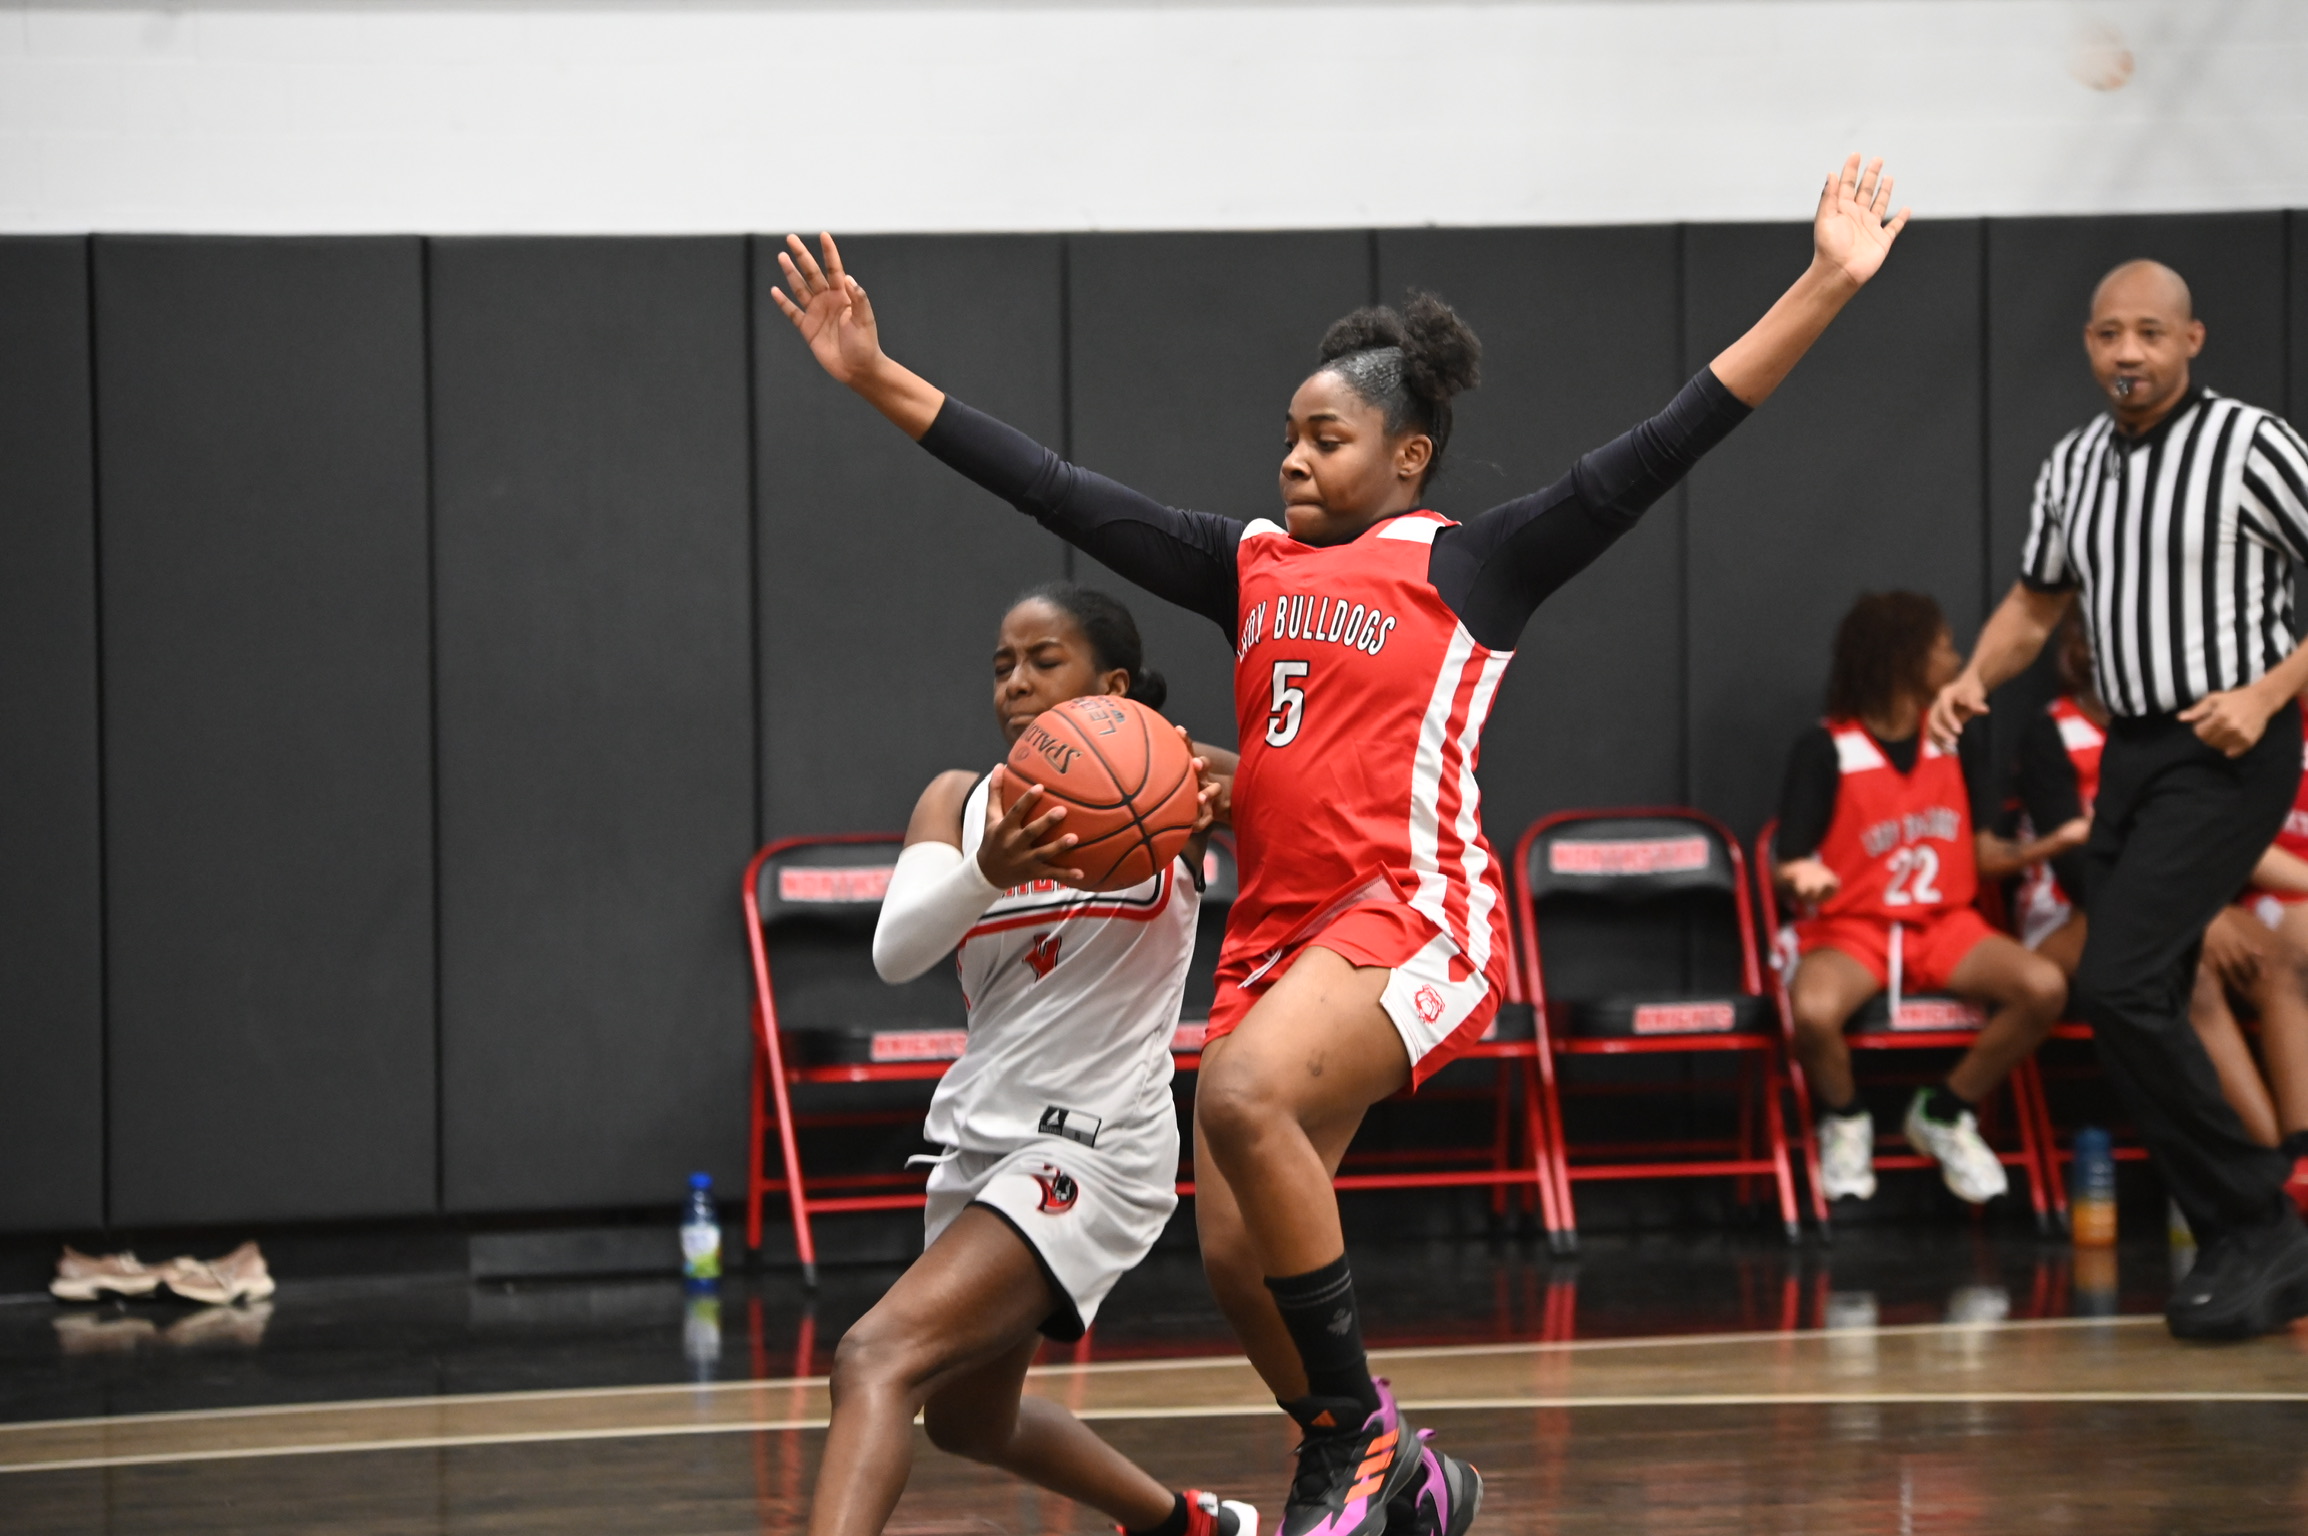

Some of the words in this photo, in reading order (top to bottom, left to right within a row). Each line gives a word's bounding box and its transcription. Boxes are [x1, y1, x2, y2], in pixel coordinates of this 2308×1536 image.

[1272, 595, 1397, 656] BULLDOGS
[1264, 659, 1310, 748] 5
[1884, 844, 1944, 906] 22
